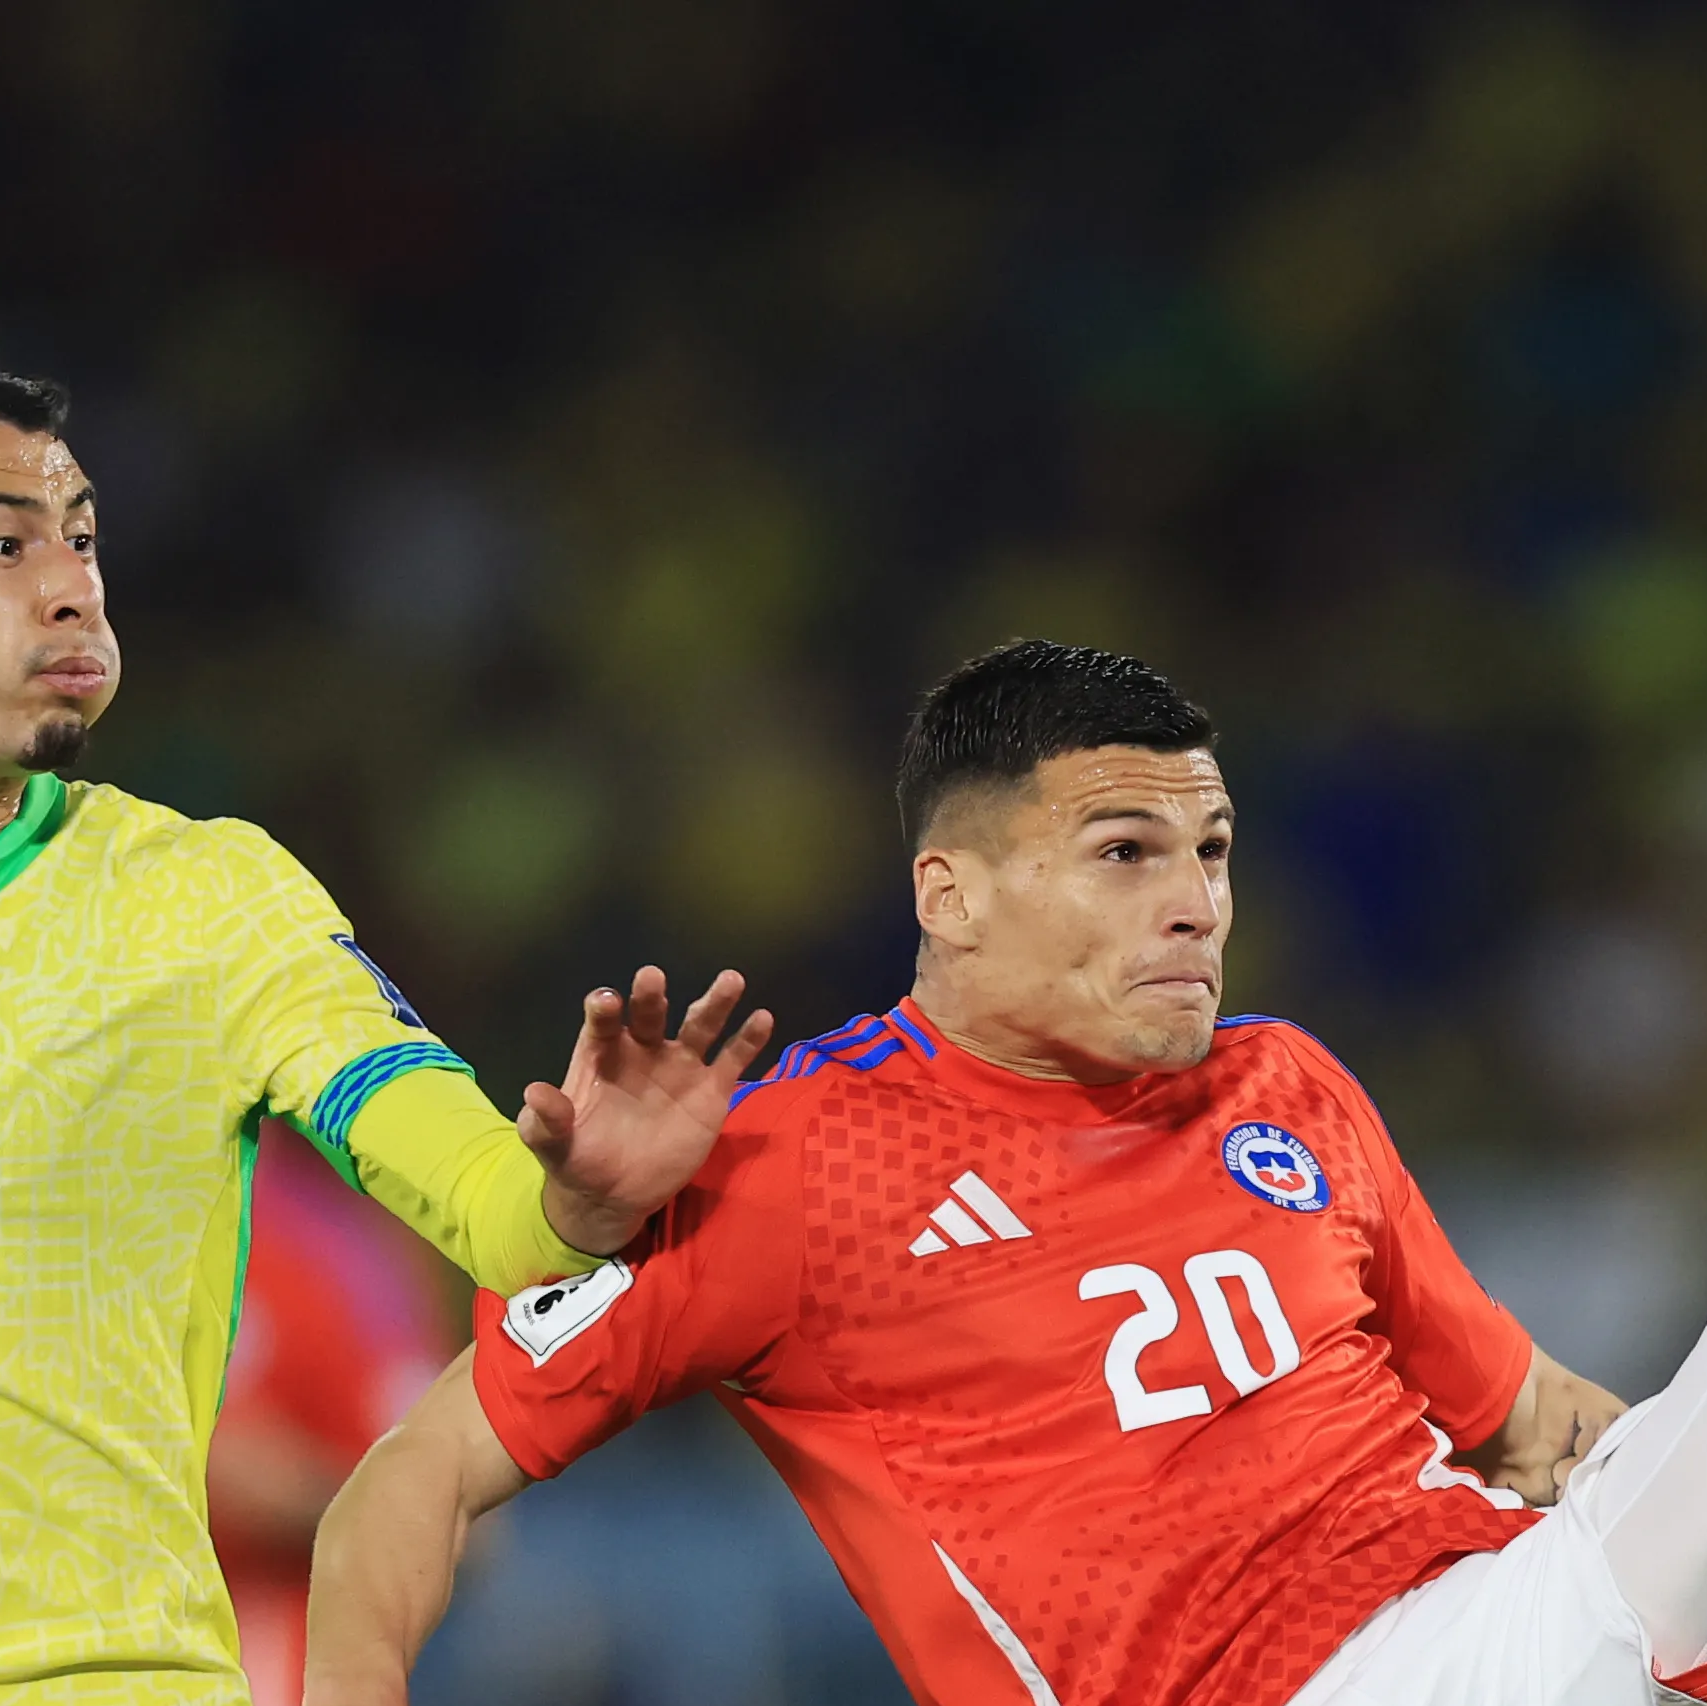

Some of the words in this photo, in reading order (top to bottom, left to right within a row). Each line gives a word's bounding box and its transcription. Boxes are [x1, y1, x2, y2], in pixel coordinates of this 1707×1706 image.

[1266, 1126, 1283, 1142] DE
[1273, 1197, 1290, 1208] DE
[1078, 1249, 1301, 1433] 20
